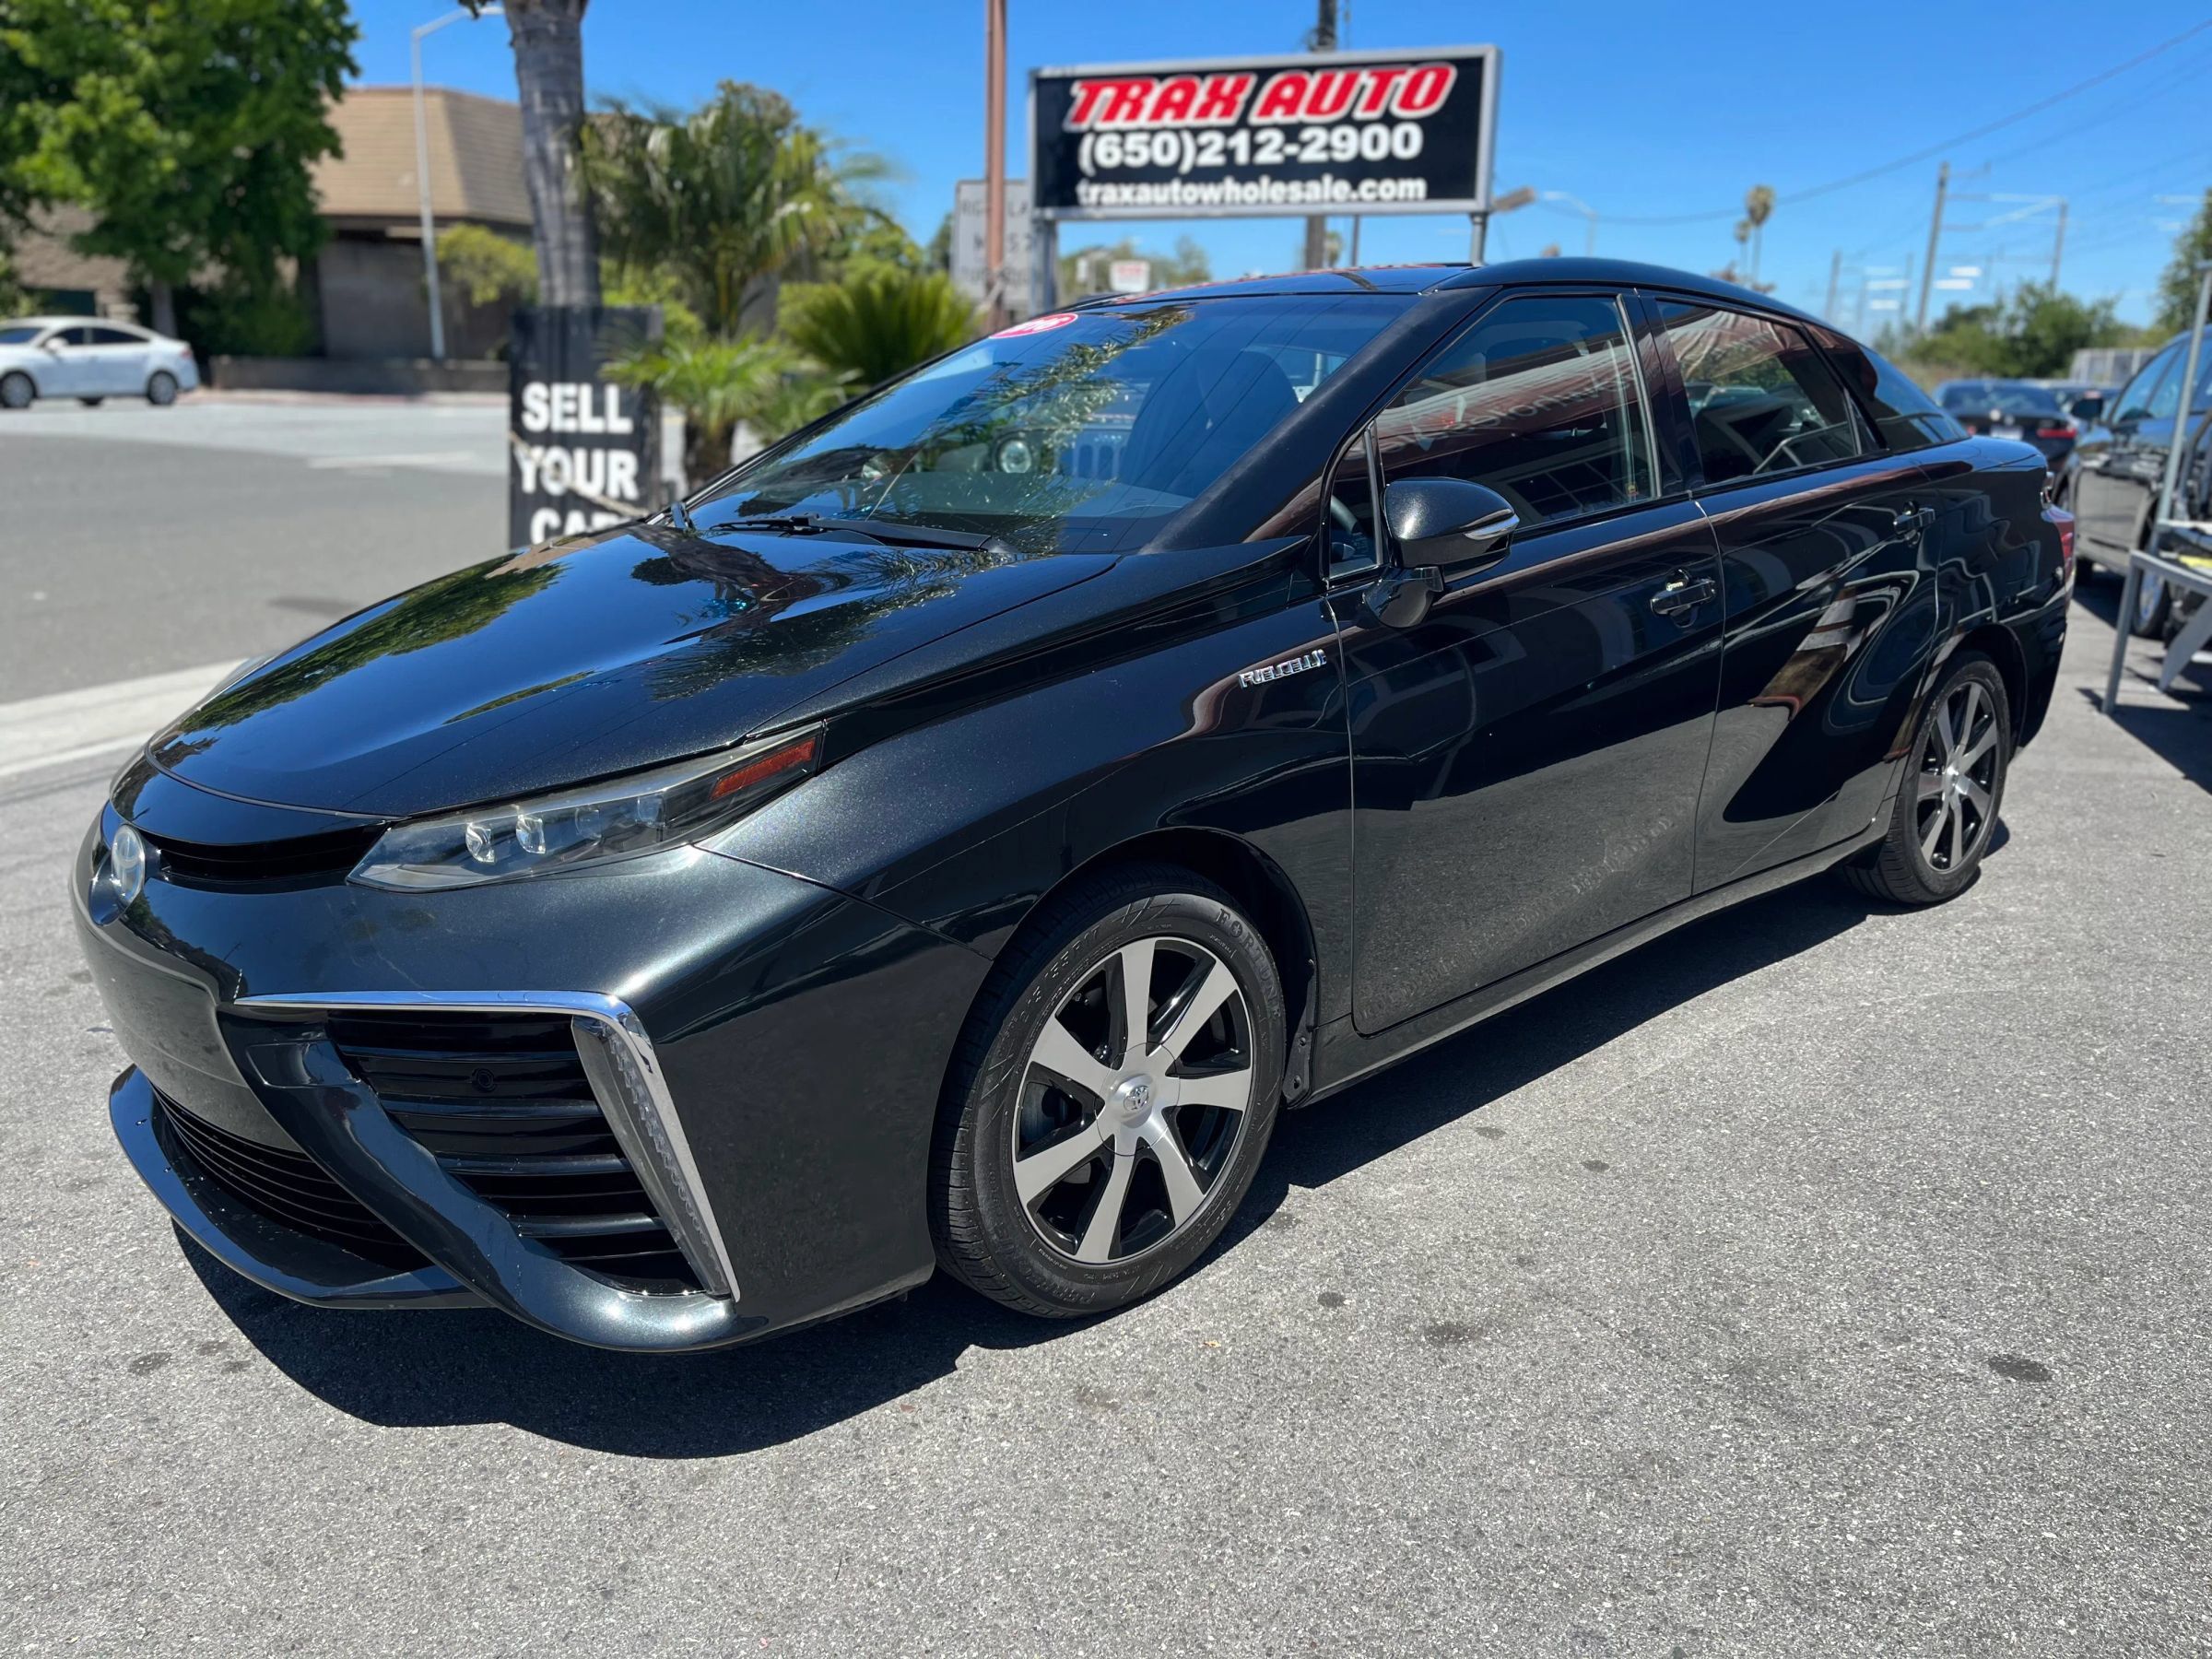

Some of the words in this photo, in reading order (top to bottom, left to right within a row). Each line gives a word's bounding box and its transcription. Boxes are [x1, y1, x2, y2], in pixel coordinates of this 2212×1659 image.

[1064, 72, 1257, 132] TRAX
[1248, 63, 1457, 125] AUTO
[1078, 122, 1424, 176] (650)212-2900
[1077, 173, 1427, 205] traxautowholesale.com
[522, 382, 633, 433] SELL
[513, 446, 640, 500] YOUR
